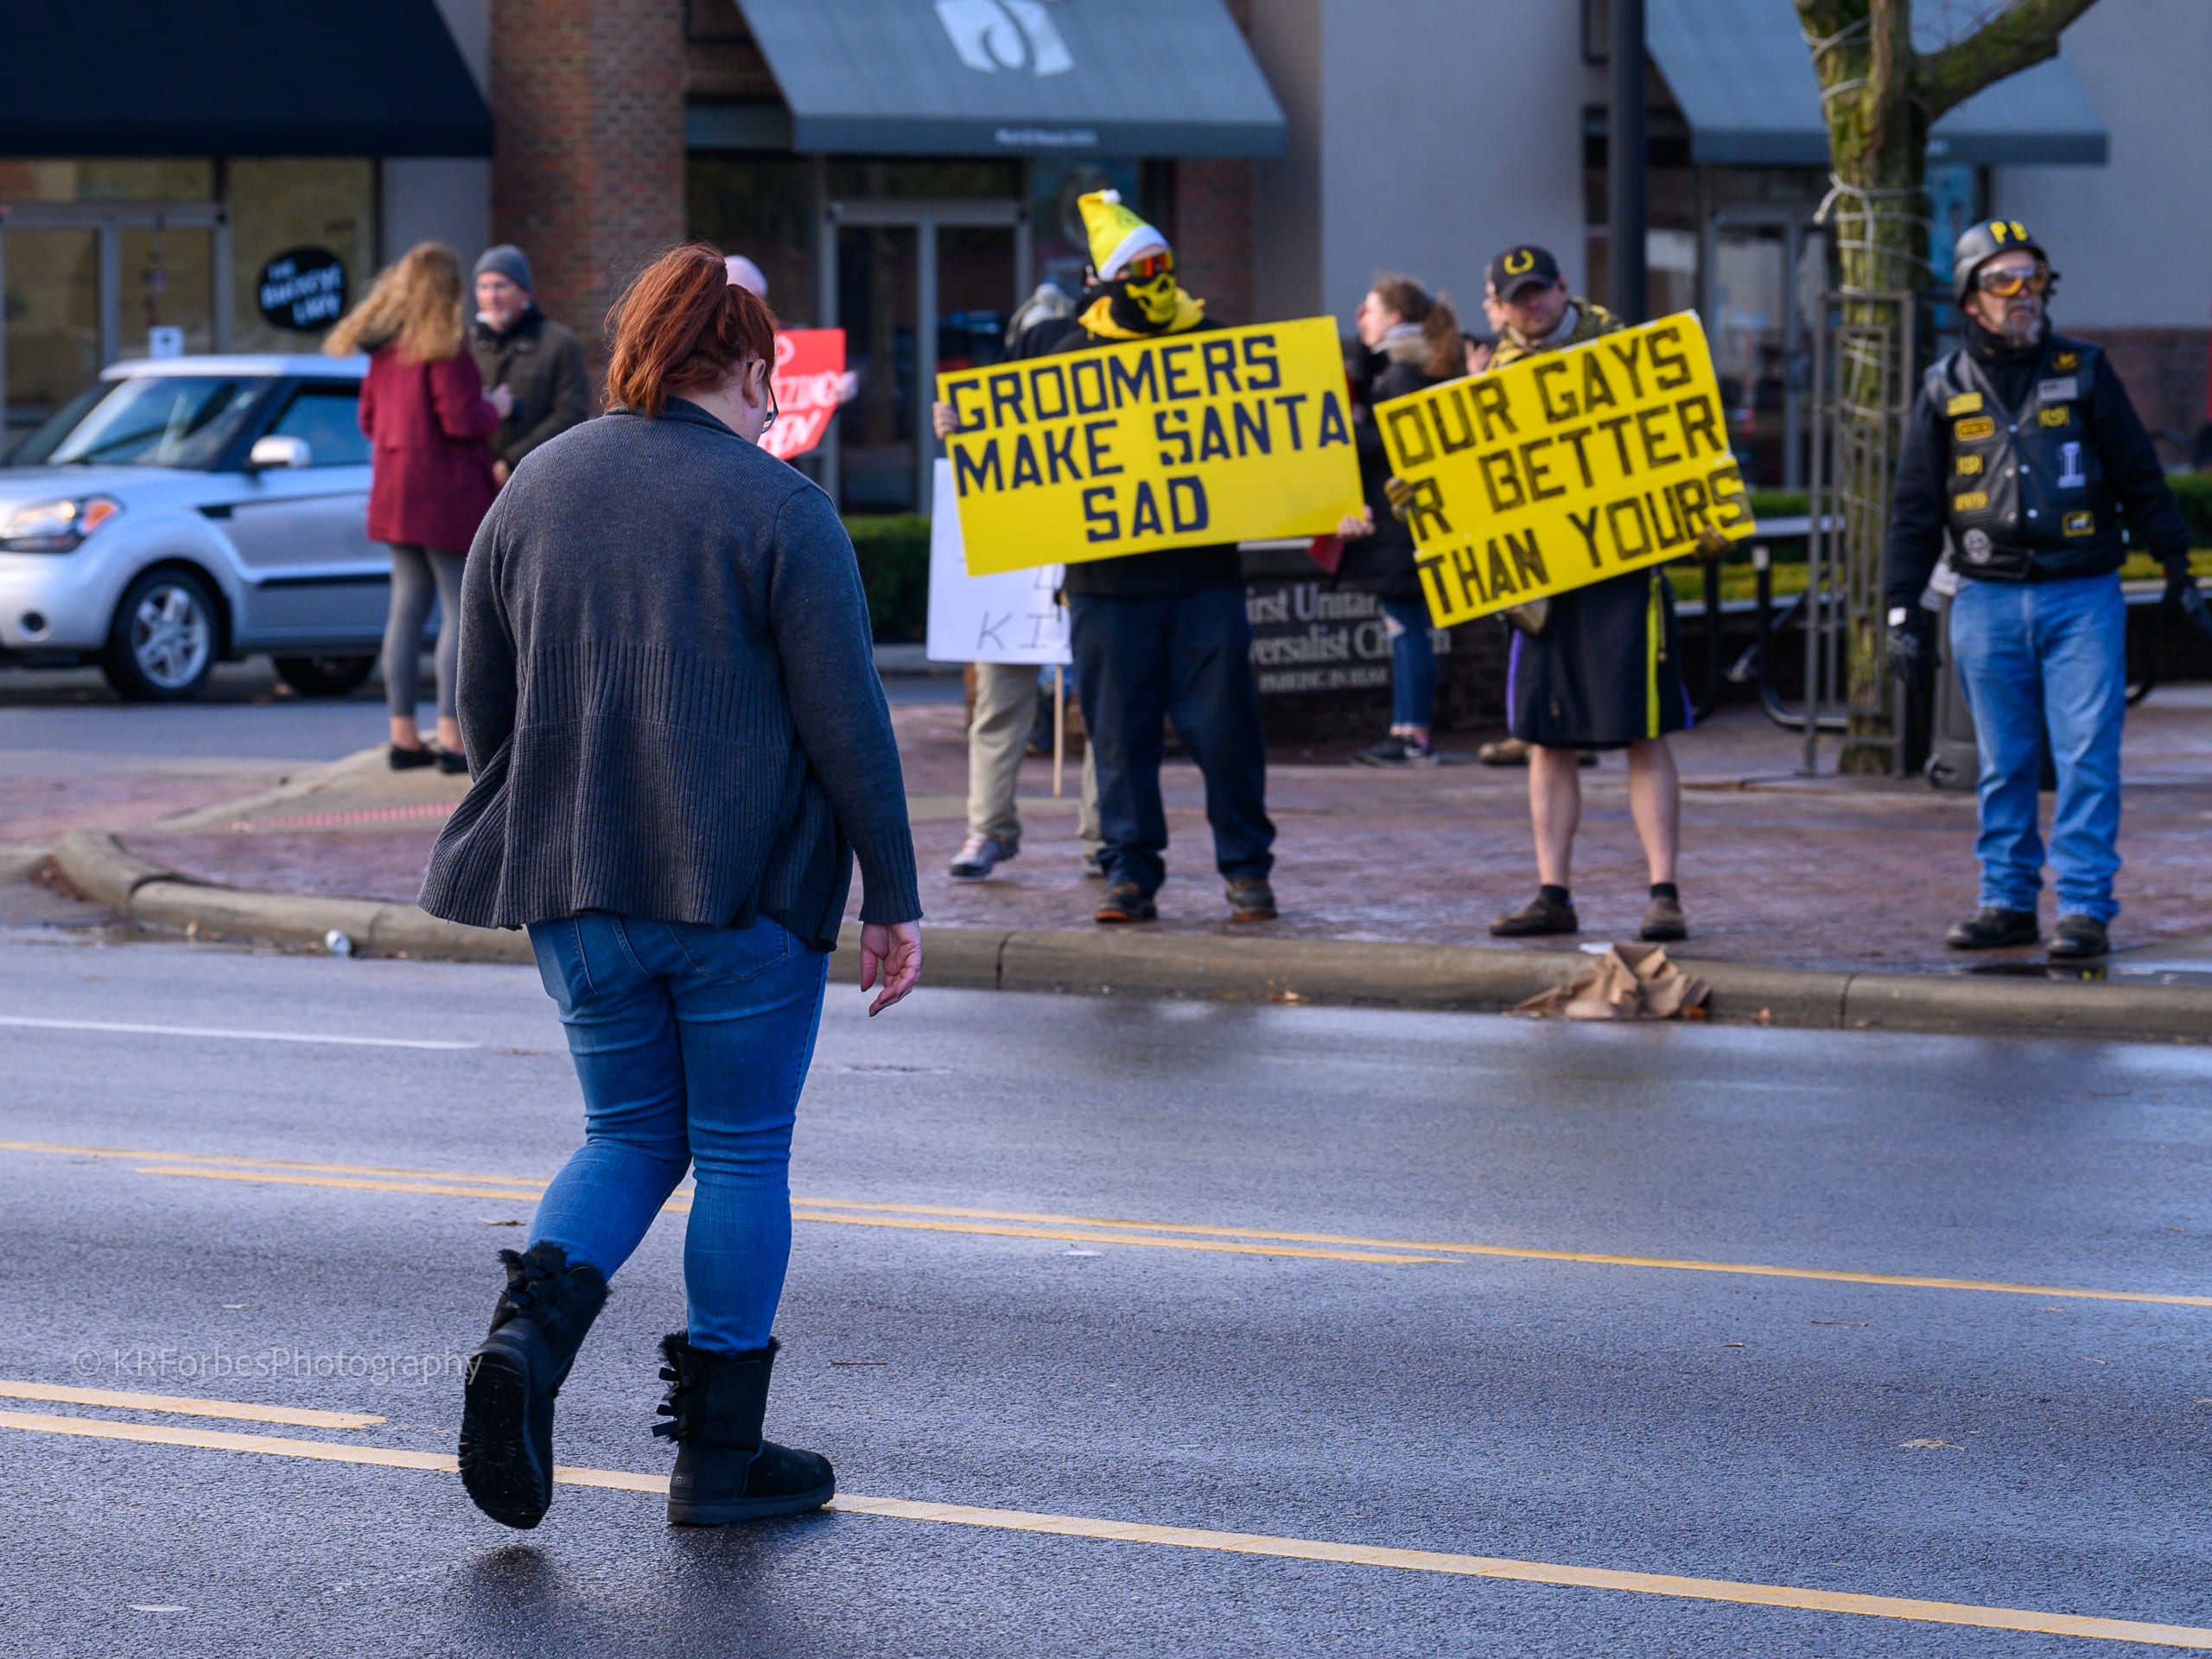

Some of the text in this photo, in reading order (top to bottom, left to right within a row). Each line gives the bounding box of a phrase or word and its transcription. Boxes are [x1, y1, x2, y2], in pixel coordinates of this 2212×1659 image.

[947, 334, 1281, 434] GROOMERS
[1387, 327, 1693, 469] OUR GAYS
[953, 391, 1351, 498] MAKE SANTA
[1410, 394, 1724, 542] R BETTER
[1082, 475, 1210, 543] SAD
[1417, 467, 1745, 616] THAN YOURS
[1245, 582, 1384, 623] irst Unitar
